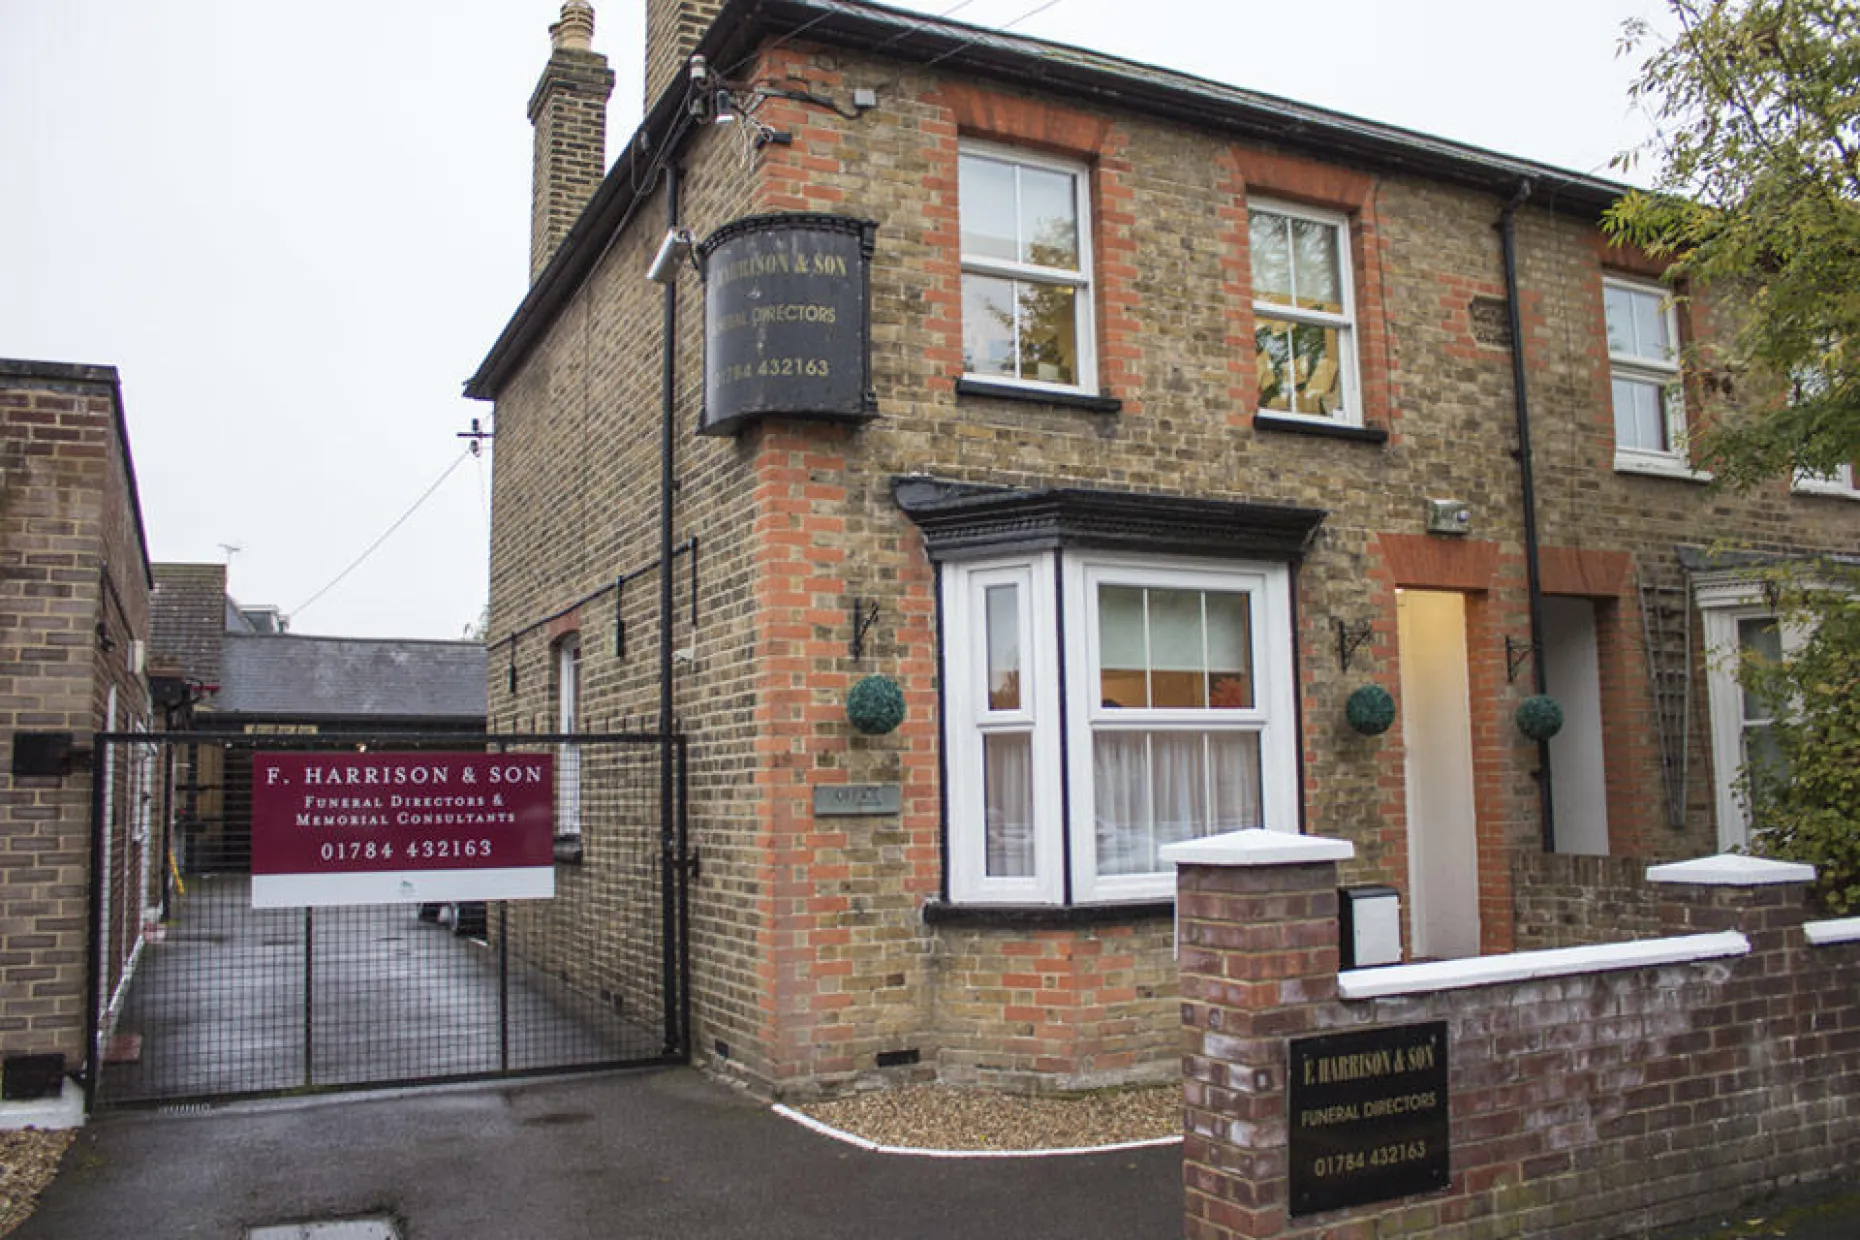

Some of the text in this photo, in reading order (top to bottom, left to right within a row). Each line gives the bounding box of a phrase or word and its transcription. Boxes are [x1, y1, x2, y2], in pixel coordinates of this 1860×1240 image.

[794, 252, 809, 273] &
[814, 255, 848, 276] SON
[752, 304, 836, 324] DIRECTORS
[757, 358, 829, 377] 432163
[266, 766, 542, 785] F. HARRISON & SON
[492, 794, 504, 807] &
[320, 839, 493, 861] 01784 432163
[1318, 1051, 1390, 1083] HARRISON
[1394, 1048, 1405, 1073] &
[1408, 1044, 1434, 1071] SON
[1301, 1091, 1436, 1127] FUNERAL DIRECTORS
[1314, 1140, 1427, 1177] 01784 432163
